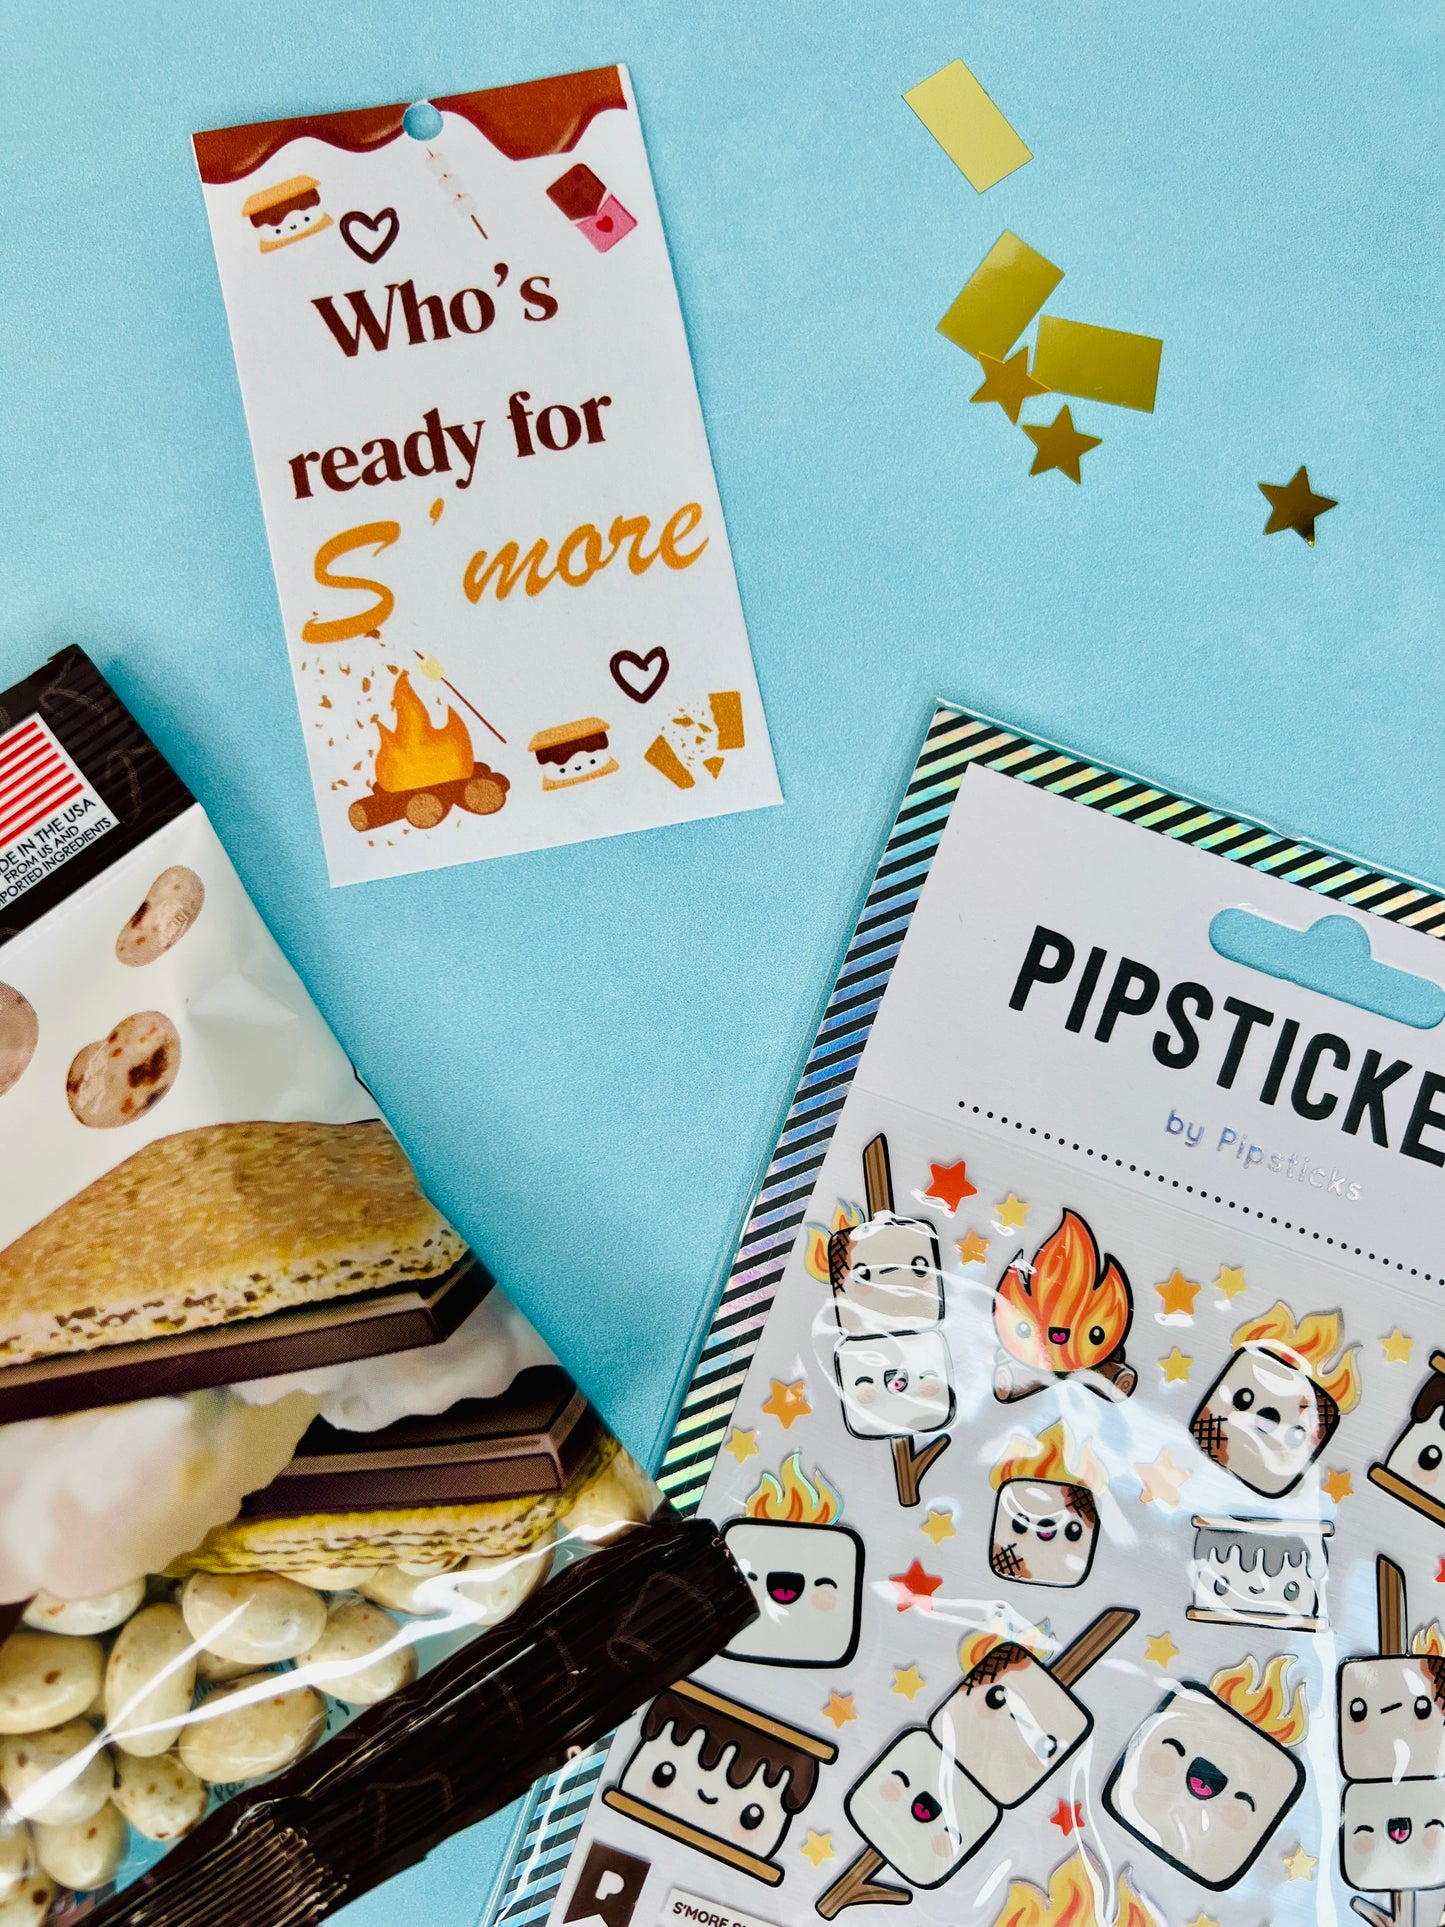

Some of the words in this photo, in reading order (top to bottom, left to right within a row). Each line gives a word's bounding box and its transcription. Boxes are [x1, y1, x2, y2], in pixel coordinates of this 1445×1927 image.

[310, 263, 559, 357] Who’s
[288, 408, 486, 500] ready
[506, 391, 612, 458] for
[4, 855, 39, 883] FROM
[37, 844, 53, 858] US
[54, 826, 79, 848] AND
[17, 838, 36, 857] IN
[34, 817, 65, 842] THE
[63, 798, 97, 823] USA
[42, 817, 111, 871] INGREDIENTS
[1009, 925, 1445, 1168] PIPSTICKE
[1165, 1109, 1204, 1147] by
[1216, 1127, 1362, 1201] Pipsticks
